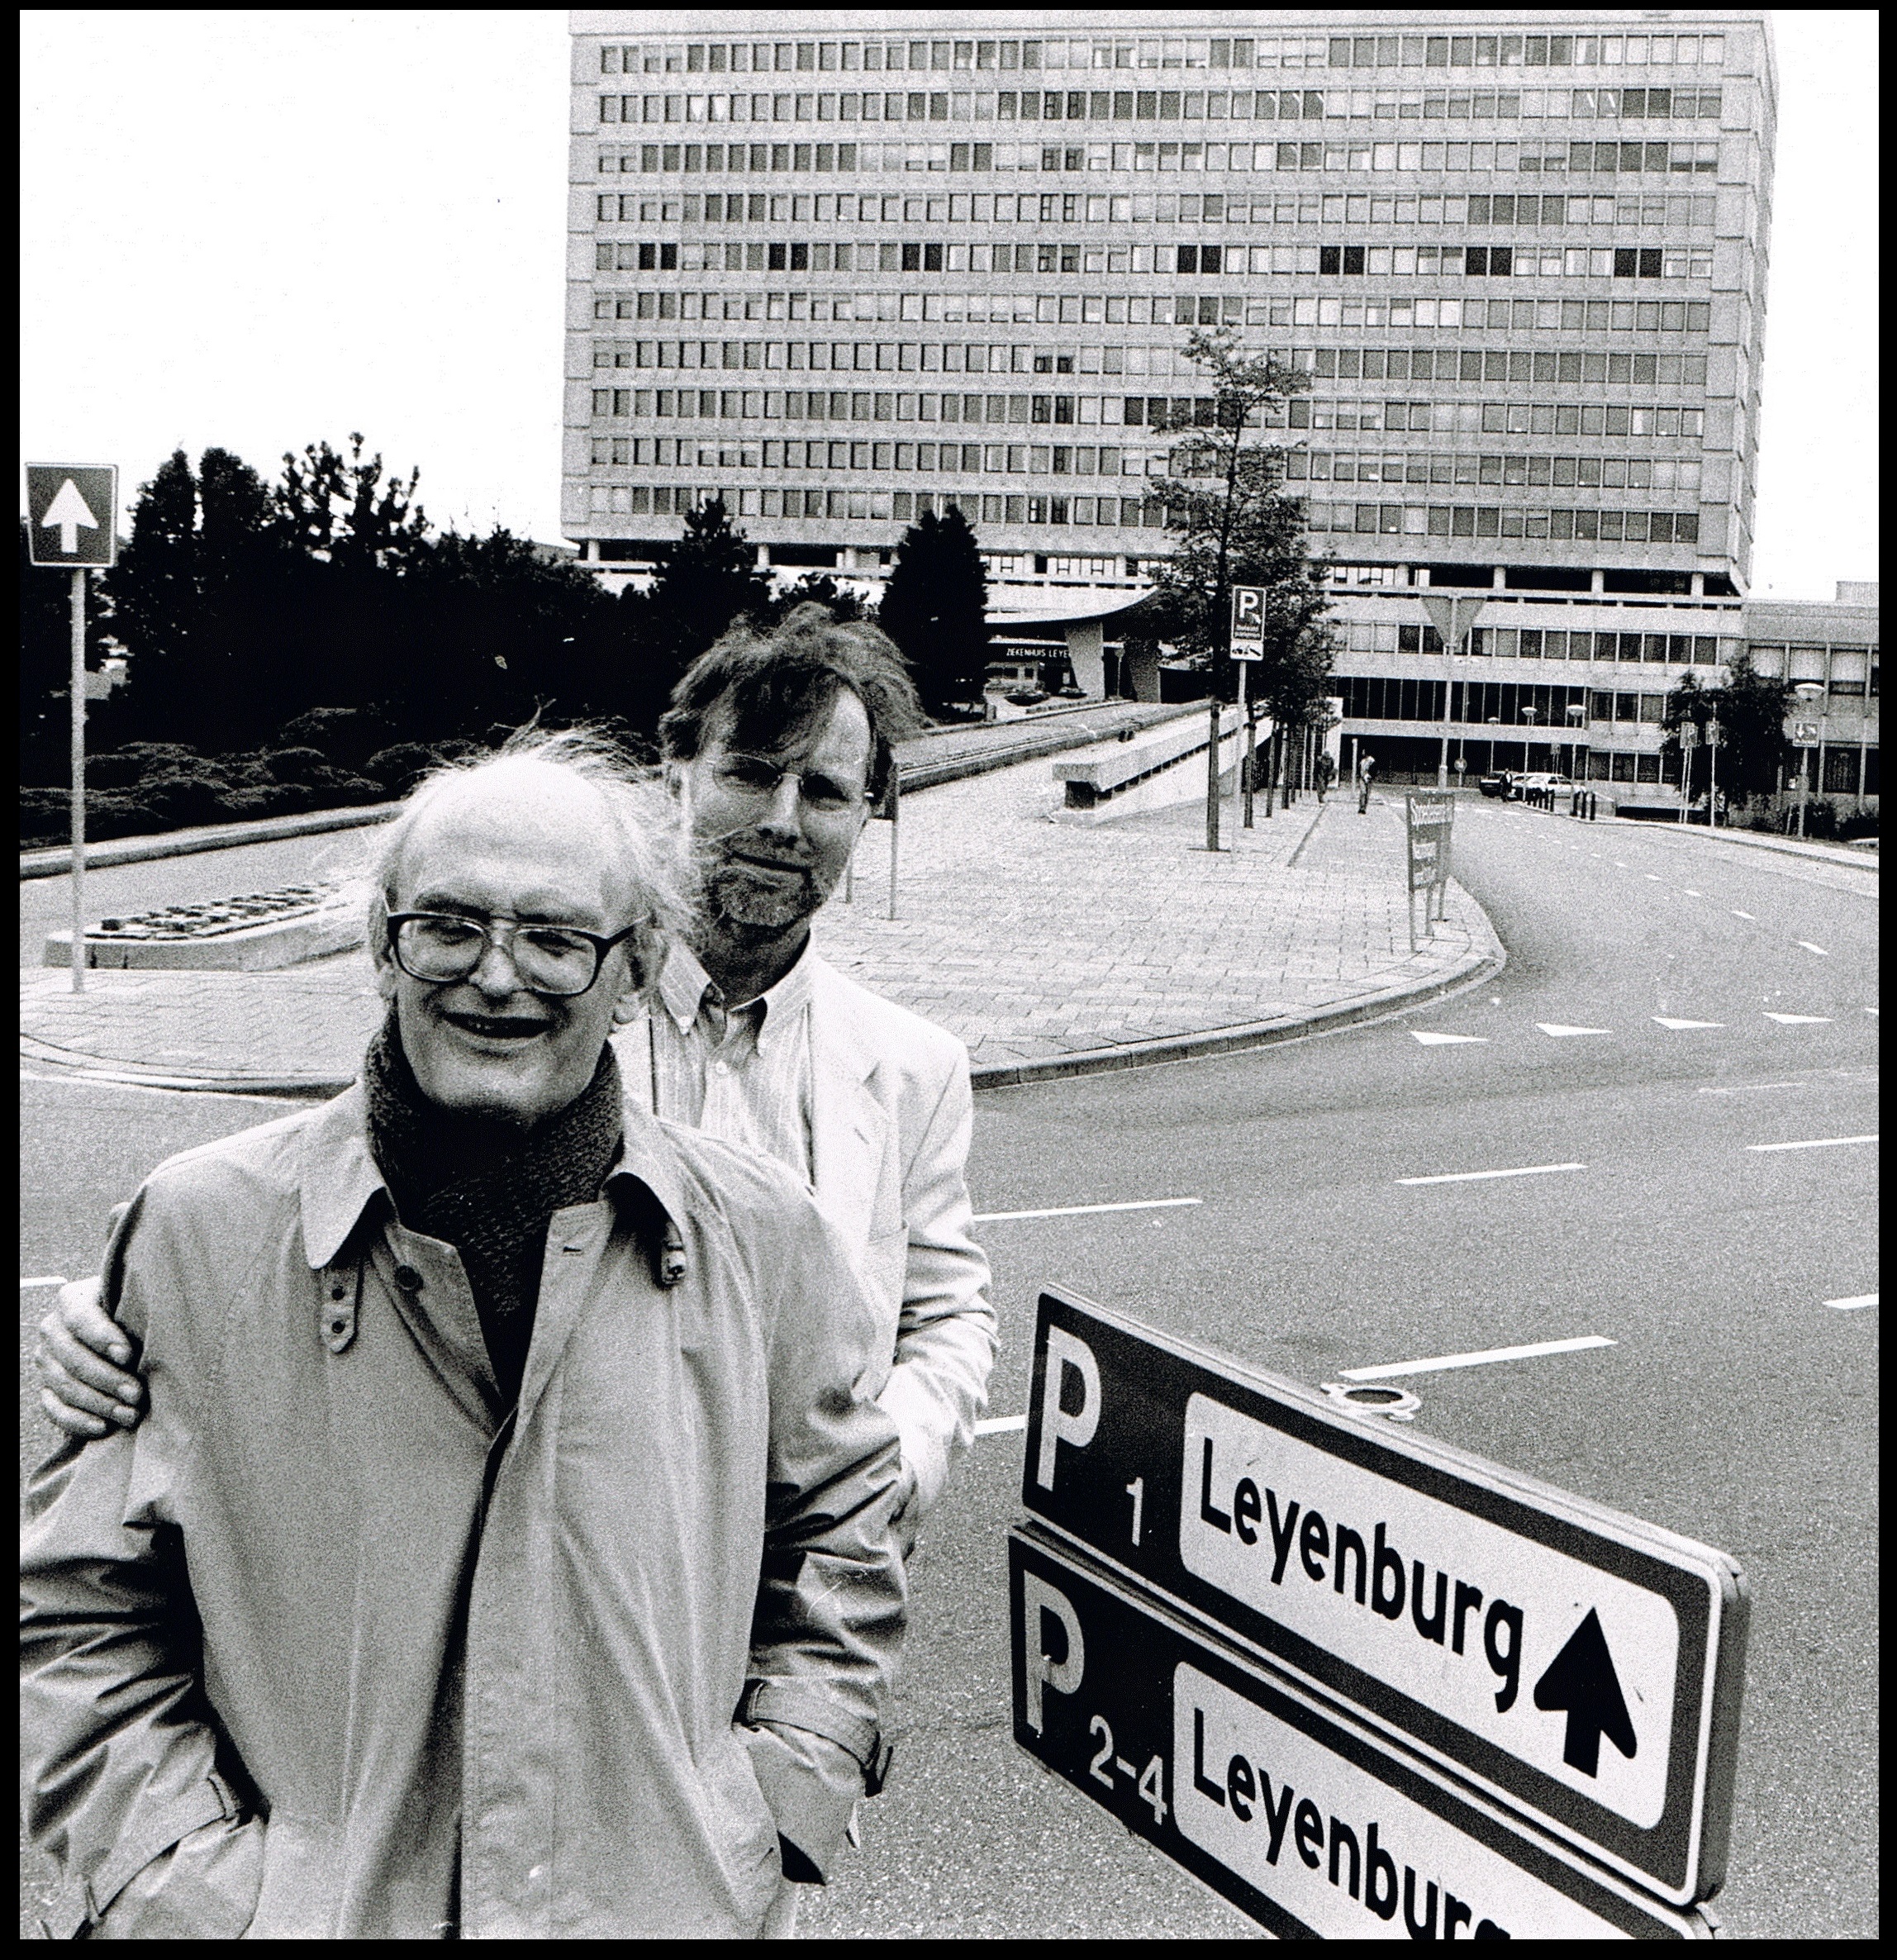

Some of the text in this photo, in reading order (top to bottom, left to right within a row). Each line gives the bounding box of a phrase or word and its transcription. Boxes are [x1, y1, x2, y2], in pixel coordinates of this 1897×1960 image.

[1048, 649, 1071, 659] LEYE
[1239, 591, 1258, 618] P
[1036, 1324, 1524, 1714] P 1 Leyenburg
[1024, 1569, 1085, 1735] P
[1089, 1715, 1167, 1826] 2-4
